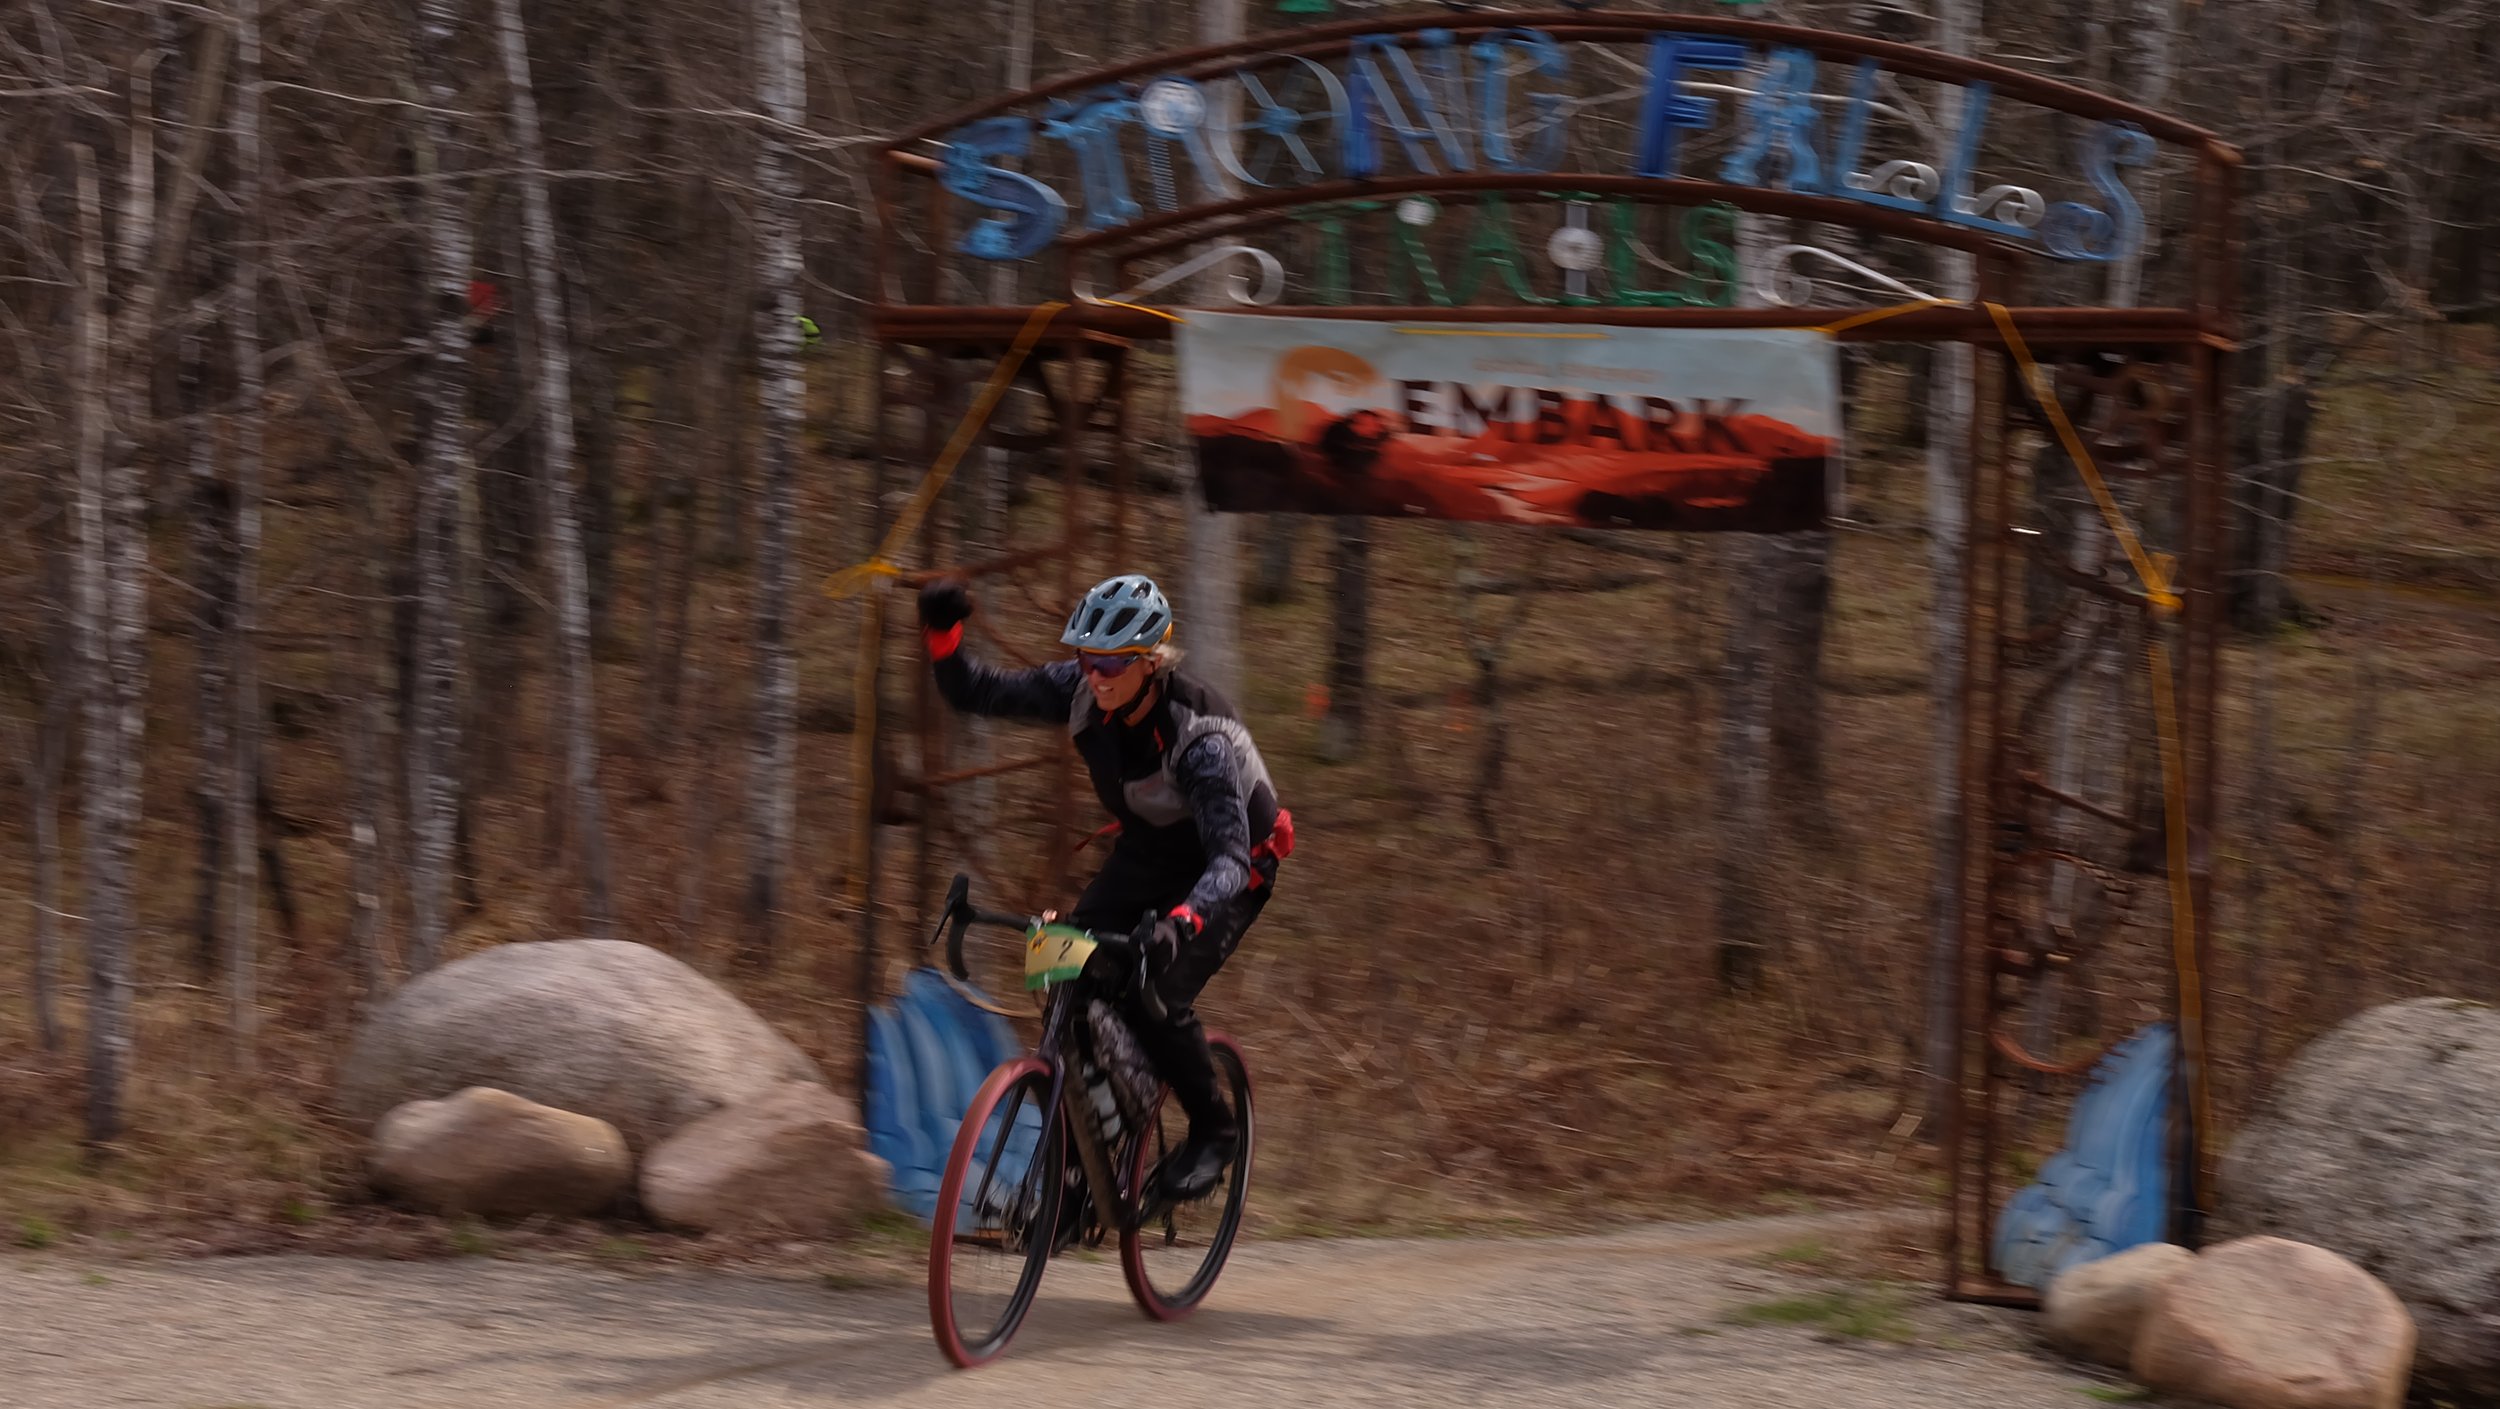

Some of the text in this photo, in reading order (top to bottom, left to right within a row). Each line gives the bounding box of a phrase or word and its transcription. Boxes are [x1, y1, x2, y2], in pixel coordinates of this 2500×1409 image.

[1636, 32, 2156, 262] FALLS
[1287, 190, 1740, 306] TRAILS
[1398, 379, 1757, 455] EMBARK
[1058, 938, 1074, 962] 2
